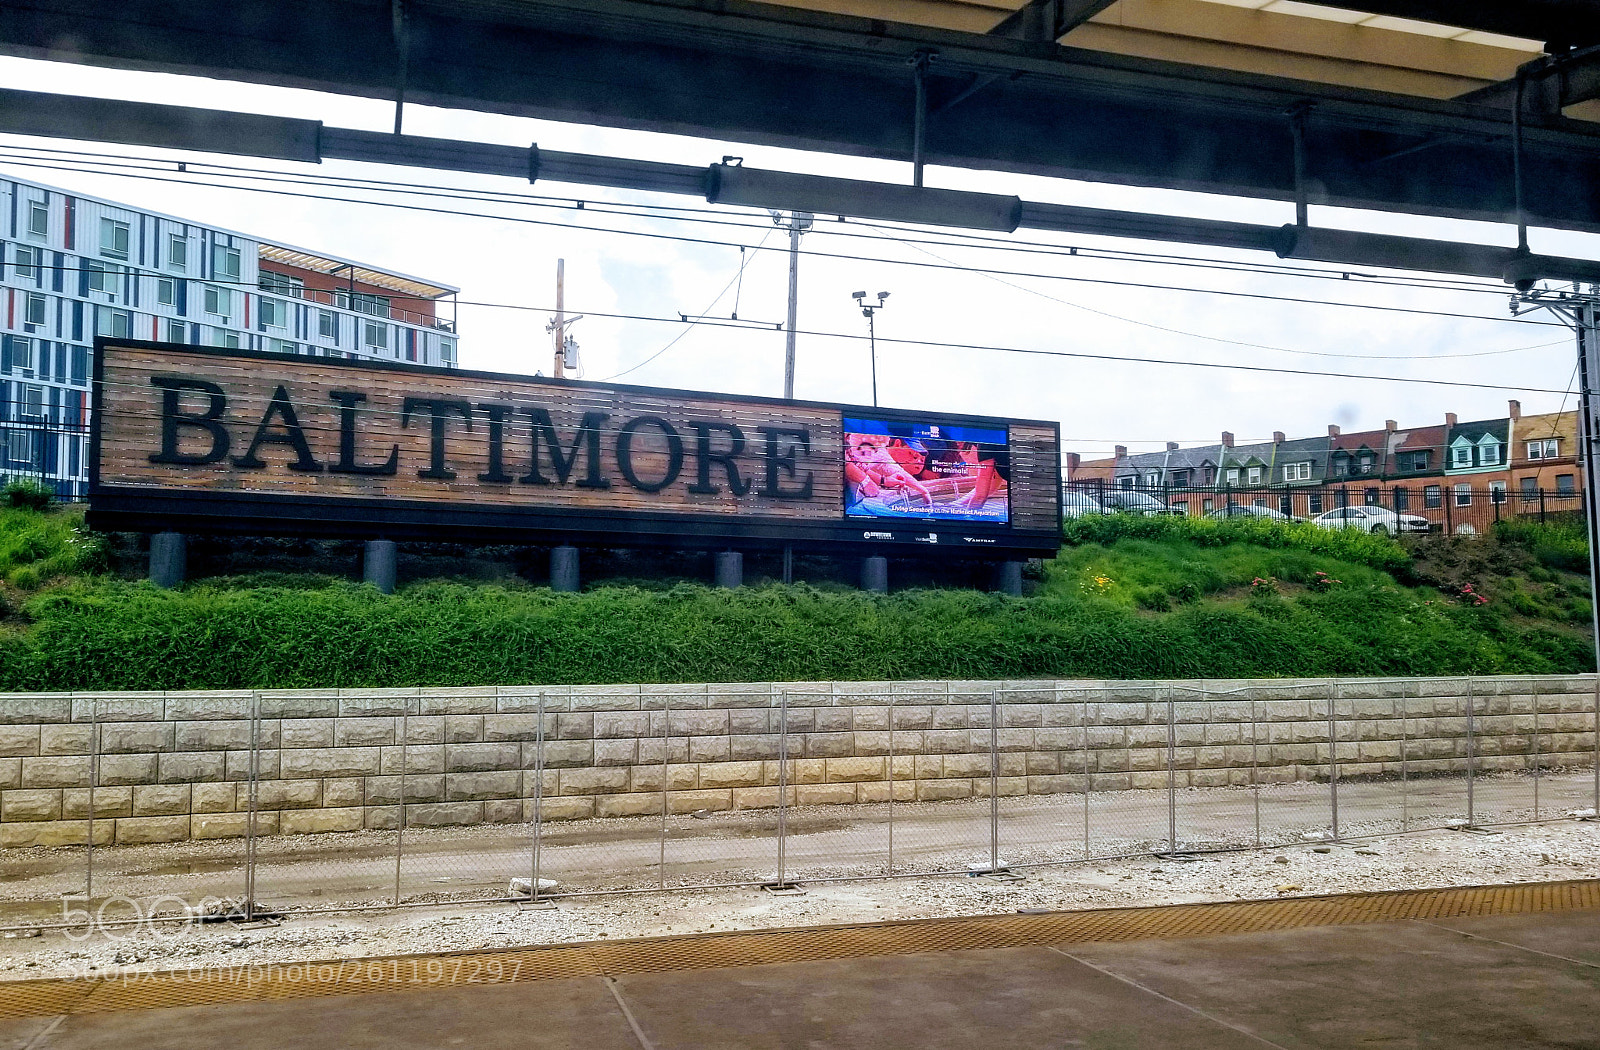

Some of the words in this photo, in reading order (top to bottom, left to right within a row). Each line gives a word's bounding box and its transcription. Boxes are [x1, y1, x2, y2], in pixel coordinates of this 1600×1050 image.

[149, 376, 814, 500] BALTIMORE
[931, 465, 943, 473] the
[891, 504, 908, 513] Living
